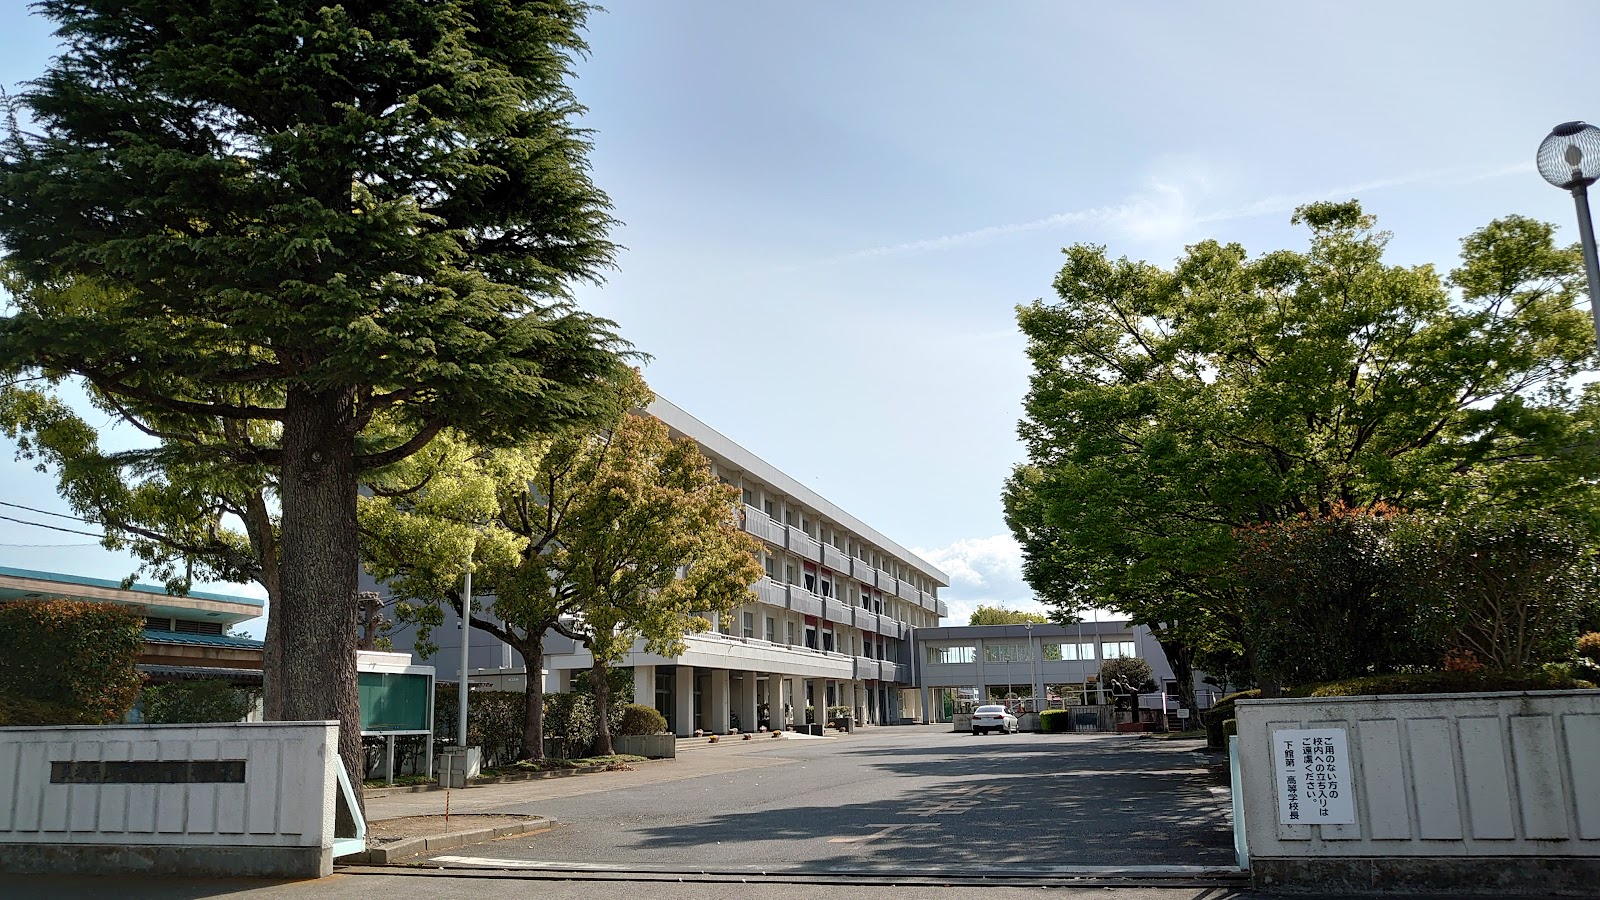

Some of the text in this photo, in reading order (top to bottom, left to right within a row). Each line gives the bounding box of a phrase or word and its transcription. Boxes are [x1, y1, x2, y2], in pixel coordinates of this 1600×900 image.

[1283, 740, 1300, 820] 下館第一高等学校長
[1302, 737, 1318, 803] ご遠慮ください。
[1313, 737, 1329, 817] 校内への立ち入りは
[1324, 737, 1339, 799] ご用のない方の
